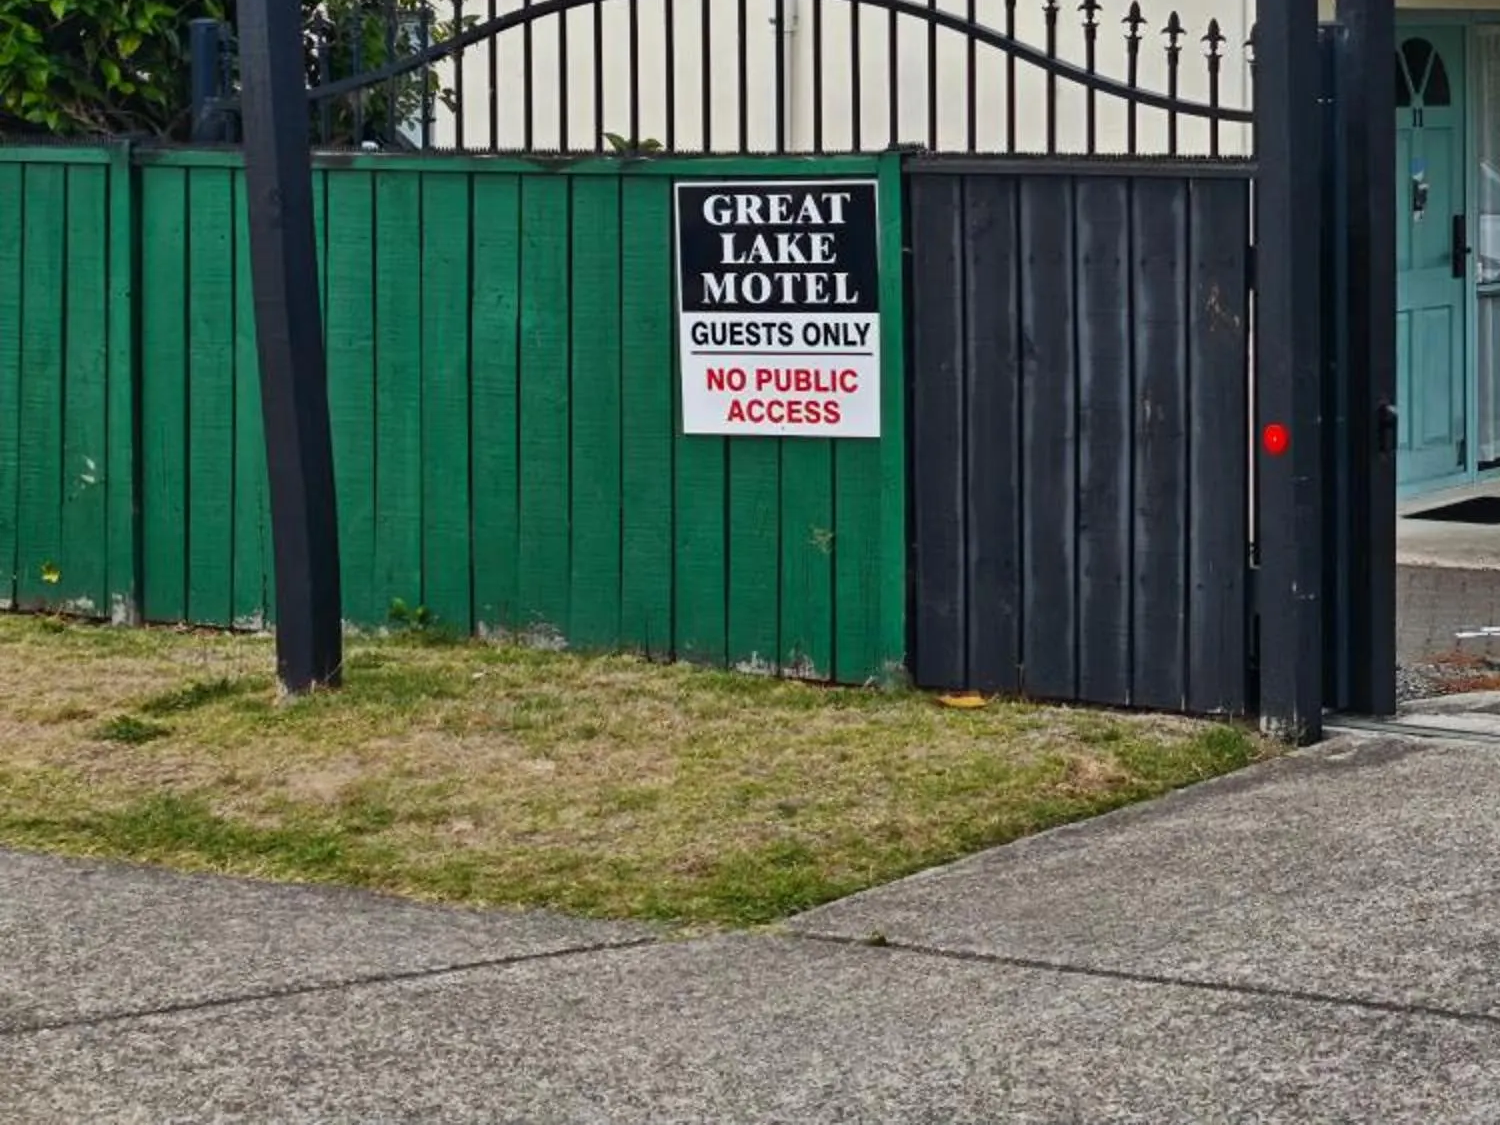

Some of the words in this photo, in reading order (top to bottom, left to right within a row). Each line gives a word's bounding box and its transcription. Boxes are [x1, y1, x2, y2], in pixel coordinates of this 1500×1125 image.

[703, 193, 851, 225] GREAT
[720, 232, 837, 264] LAKE
[701, 272, 859, 304] MOTEL
[691, 321, 794, 347] GUESTS
[802, 322, 871, 347] ONLY
[706, 368, 746, 392] NO
[756, 368, 859, 393] PUBLIC
[727, 399, 841, 424] ACCESS
